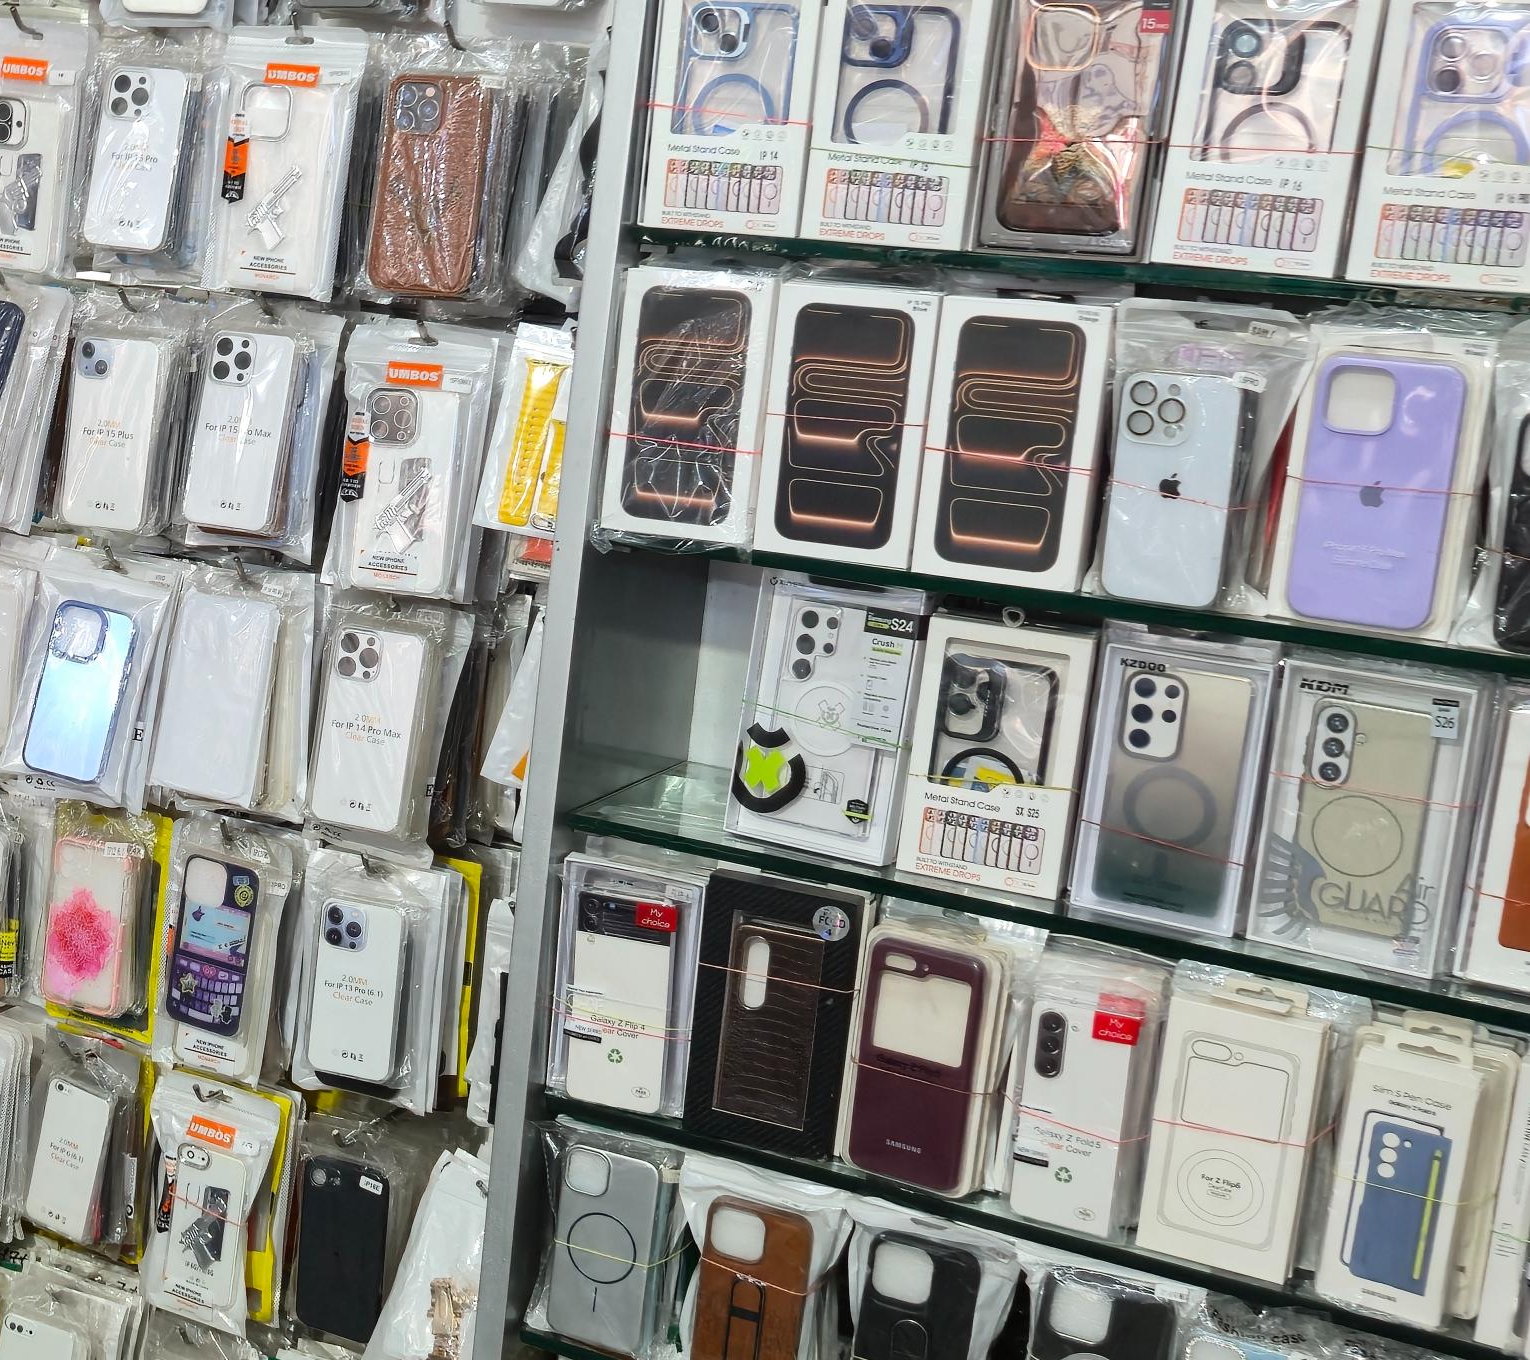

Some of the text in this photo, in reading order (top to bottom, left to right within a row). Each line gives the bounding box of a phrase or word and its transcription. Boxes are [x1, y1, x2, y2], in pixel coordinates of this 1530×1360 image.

[3, 63, 46, 76] UMBOS
[268, 70, 317, 82] UMBOS
[668, 143, 691, 154] Metal
[691, 145, 712, 155] Stand
[713, 147, 740, 157] Case
[768, 151, 779, 161] 14
[1186, 171, 1214, 182] Metal
[1215, 174, 1243, 184] Stand
[1244, 176, 1272, 186] Case
[1443, 190, 1476, 201] Case
[661, 217, 724, 230] EXTREME DROPS
[820, 227, 885, 241] EXTREME DROPS
[250, 262, 287, 270] ACCESSORIES
[1173, 251, 1248, 267] EXTREME DROPS
[1370, 268, 1452, 283] EXTREME DROPS
[389, 368, 439, 381] UMBOS
[83, 427, 95, 435] For
[97, 428, 105, 436] IP
[117, 430, 134, 440] Plus
[205, 423, 217, 431] For
[220, 424, 227, 432] IP
[254, 429, 272, 439] Max
[368, 561, 408, 571] ACCESSORIES
[891, 618, 914, 633] S24
[872, 637, 895, 649] Crush
[1300, 677, 1349, 696] KDM
[355, 714, 381, 725] 2.0MM
[1433, 714, 1455, 731] S26
[331, 720, 401, 740] For IP 14 Pro Max
[345, 731, 385, 746] Clear Case
[925, 791, 948, 806] Metal
[949, 795, 975, 809] Stand
[976, 801, 1001, 813] Case
[1026, 806, 1040, 819] S25
[916, 862, 982, 883] EXTREME DROPS
[1318, 880, 1430, 926] GUARD
[650, 908, 664, 919] My
[641, 917, 671, 929] choice
[341, 975, 368, 986] 2.0MM
[324, 980, 335, 988] For
[354, 986, 366, 994] Pro
[367, 988, 383, 998] (6.1)
[332, 991, 373, 1006] Clear Case
[590, 1014, 616, 1027] Galaxy
[624, 1020, 639, 1031] Flip
[1109, 1018, 1125, 1029] My
[617, 1028, 639, 1041] Cover
[1098, 1029, 1133, 1041] choice
[192, 1045, 227, 1057] ACCESSORIES
[1373, 1084, 1392, 1097] Slim
[1403, 1091, 1422, 1103] Pen
[1424, 1097, 1453, 1111] Case
[190, 1121, 234, 1144] UMBOS
[1033, 1125, 1064, 1142] Galaxy
[1075, 1136, 1096, 1149] Fold
[49, 1143, 60, 1151] For
[885, 1138, 922, 1156] SAMSUNG
[1066, 1144, 1093, 1158] Cover
[51, 1153, 79, 1170] Clear Case
[1201, 1173, 1214, 1183] For
[1222, 1178, 1242, 1189] Flip6
